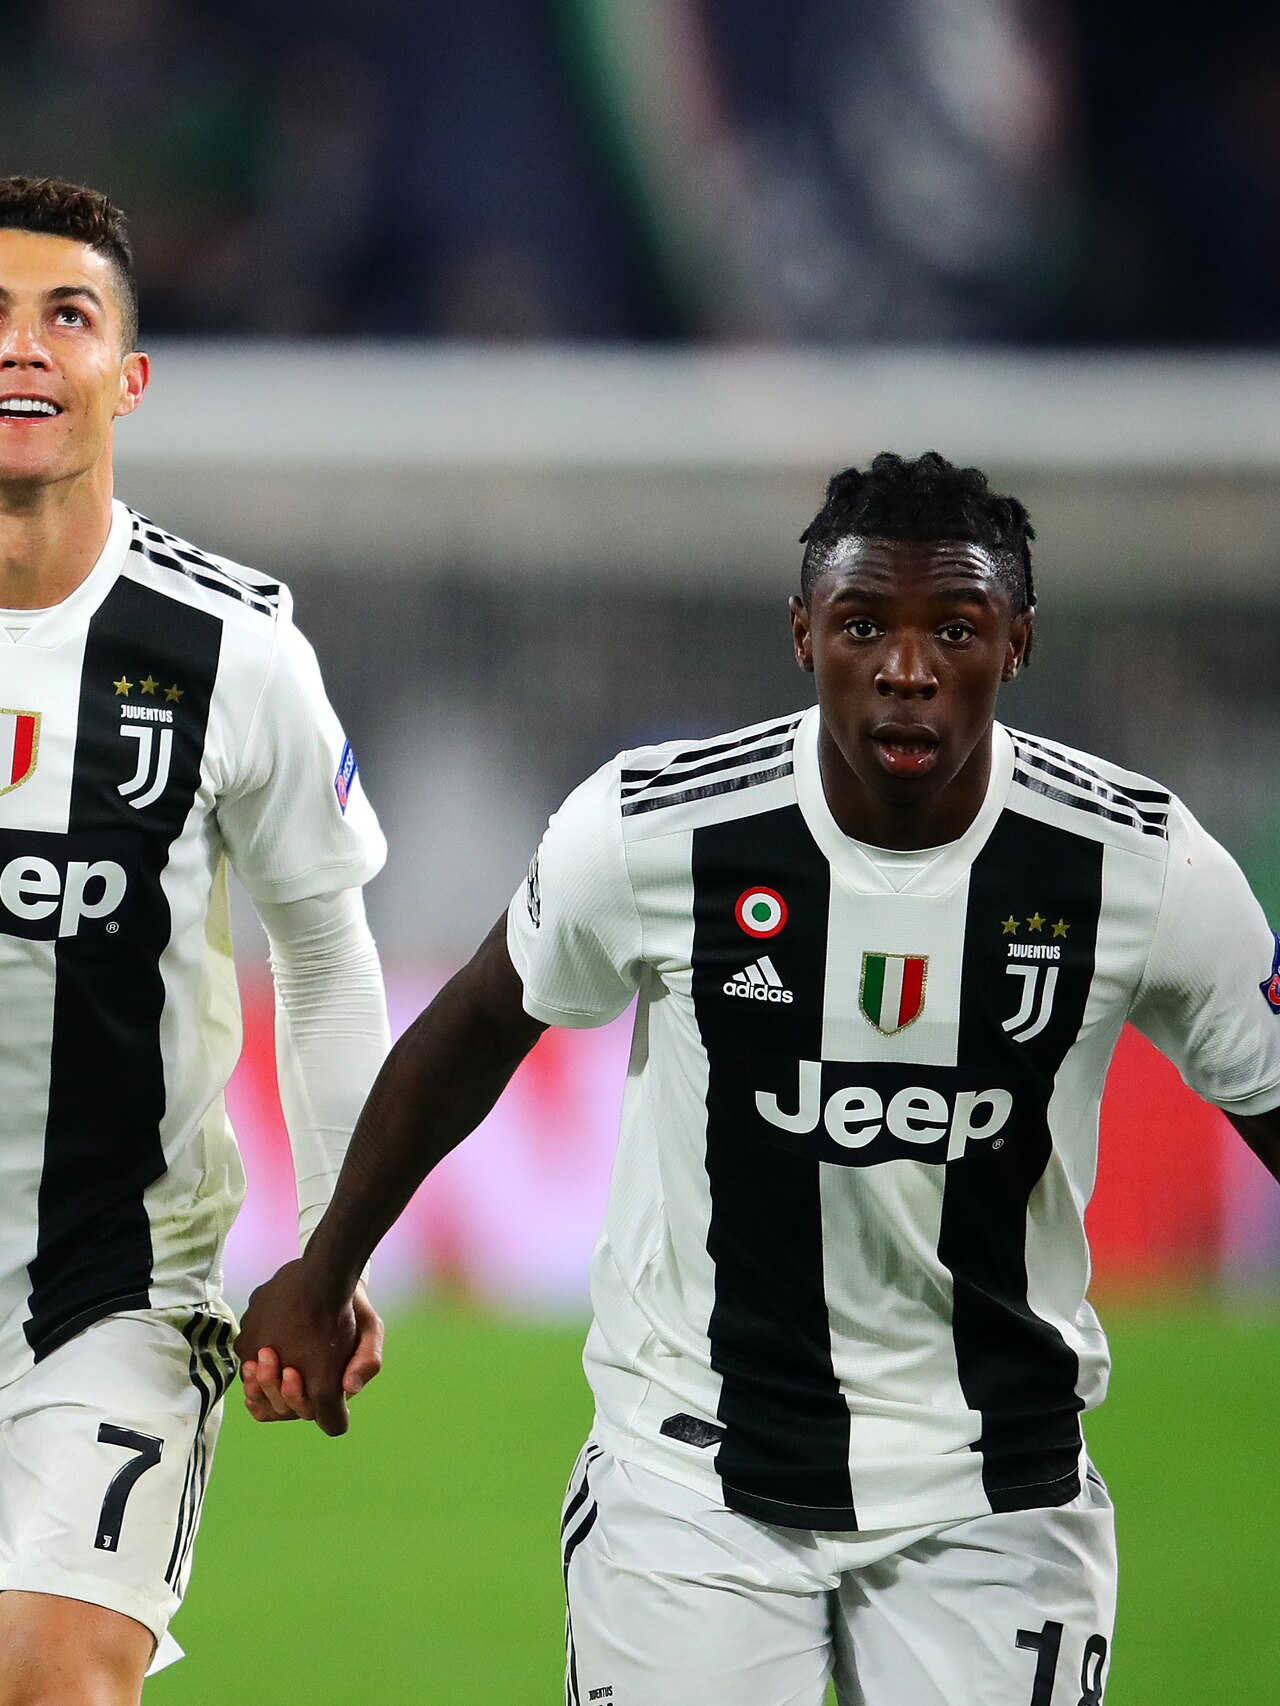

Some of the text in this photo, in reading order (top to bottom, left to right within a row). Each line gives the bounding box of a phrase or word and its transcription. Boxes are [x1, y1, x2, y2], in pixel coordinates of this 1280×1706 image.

[120, 704, 173, 723] JUVENTUS
[1007, 943, 1061, 960] JUVENTUS
[722, 981, 794, 1004] adidas
[755, 1060, 1012, 1162] Jeep
[94, 1422, 164, 1553] 7
